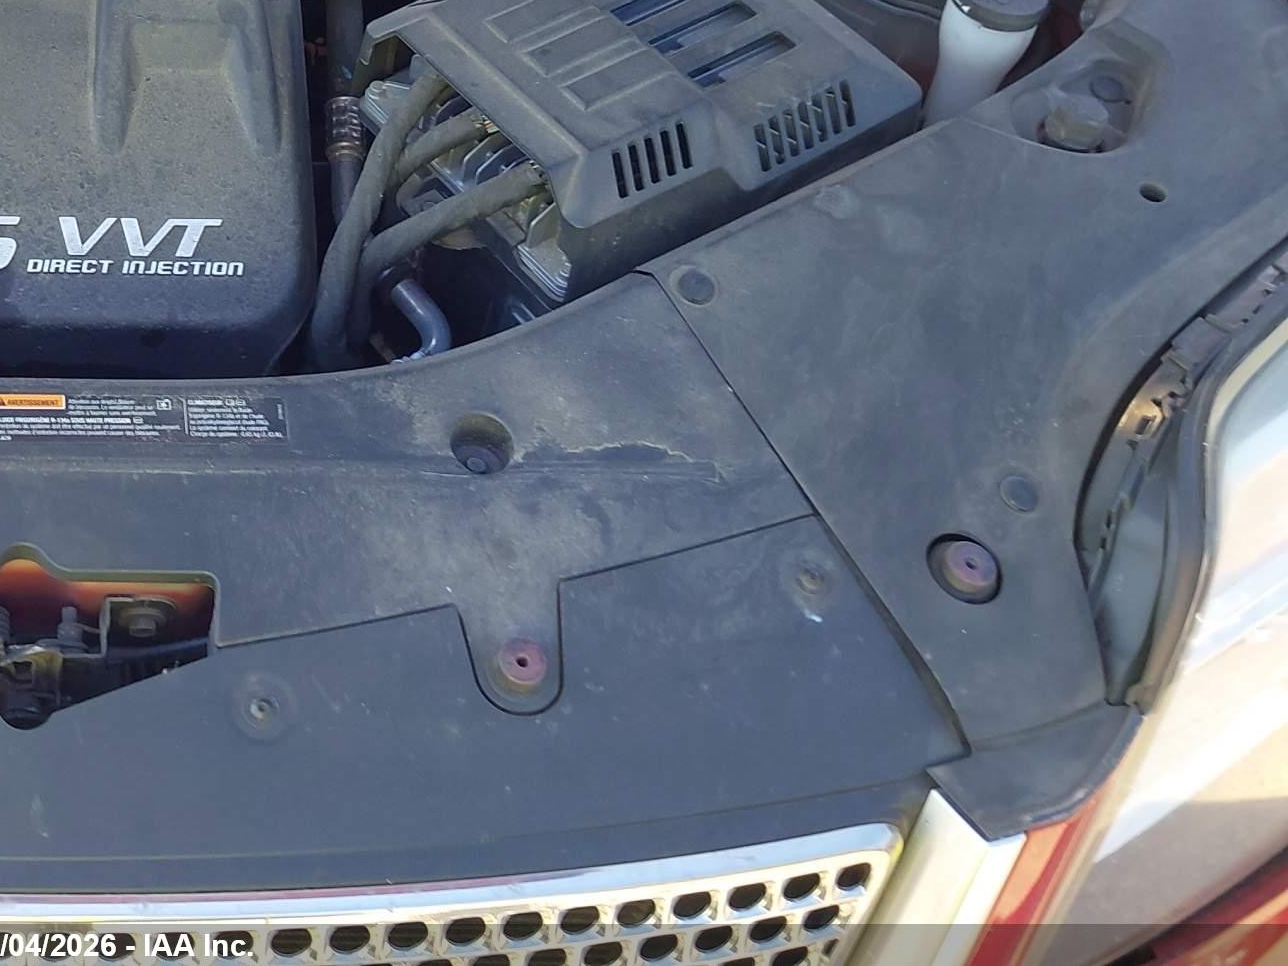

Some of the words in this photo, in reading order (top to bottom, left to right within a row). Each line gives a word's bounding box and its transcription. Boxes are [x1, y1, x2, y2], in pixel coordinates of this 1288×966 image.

[58, 216, 224, 257] VVT
[27, 259, 114, 275] DIRECT
[121, 260, 244, 277] INJECTION
